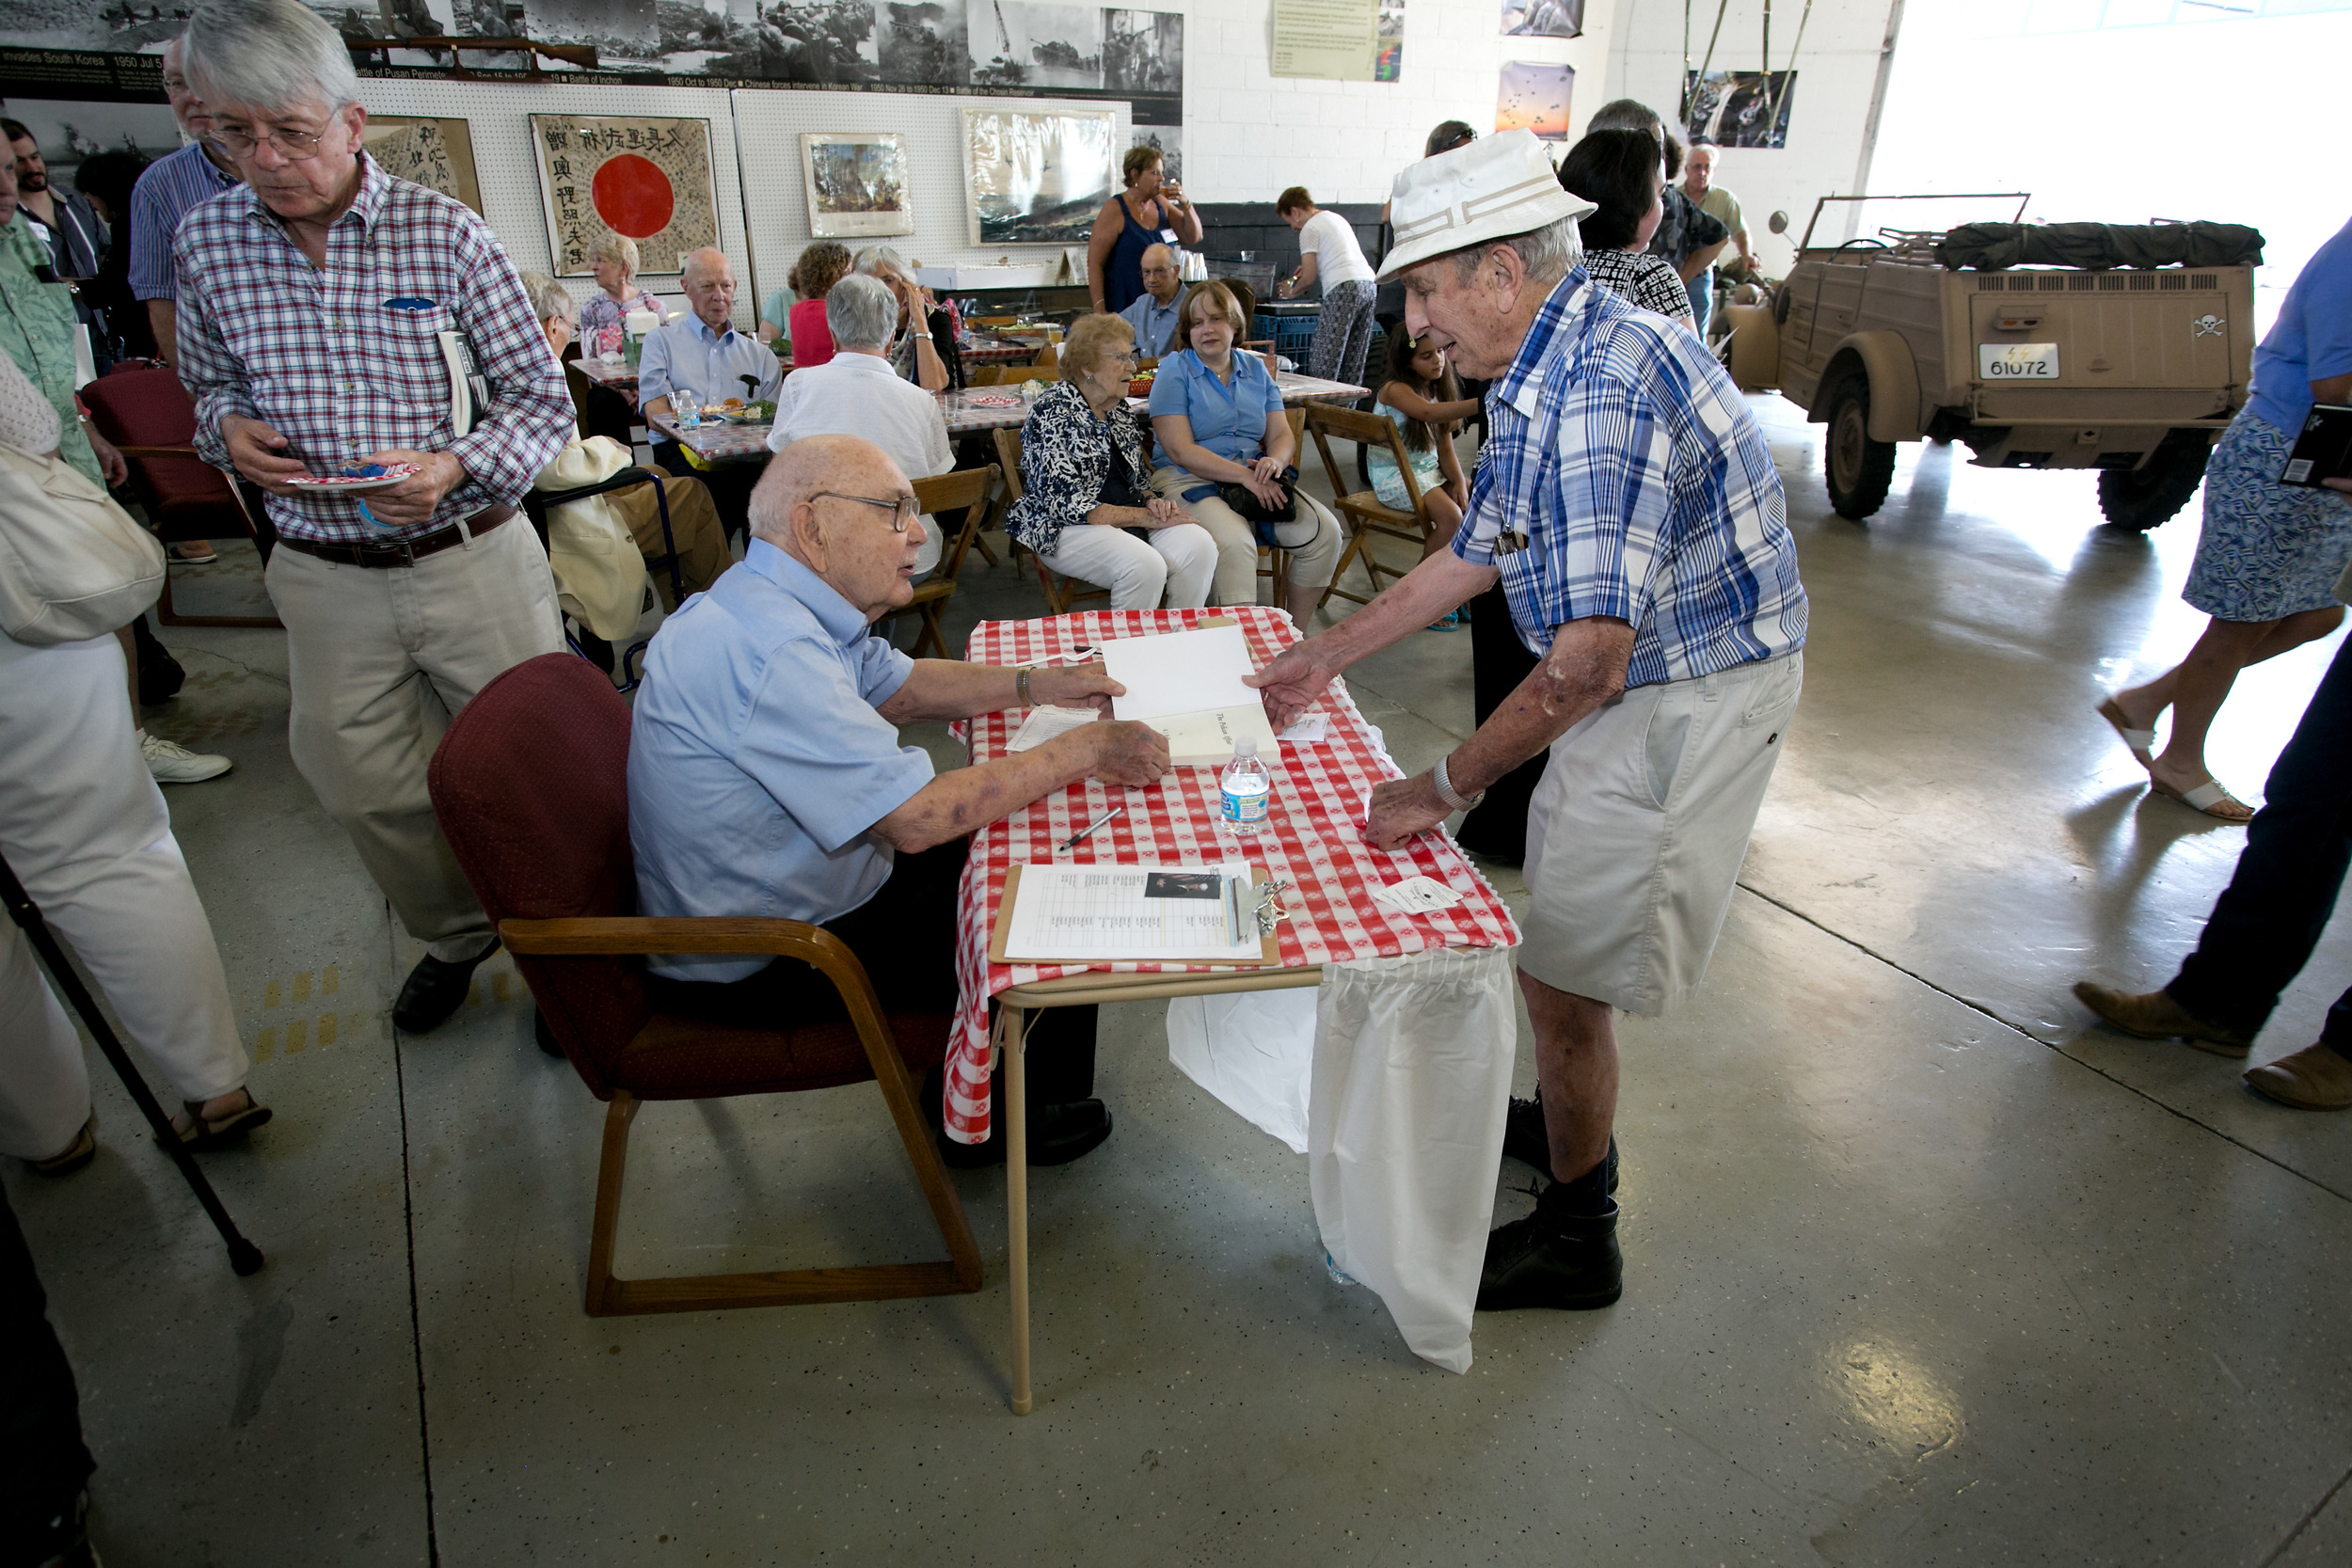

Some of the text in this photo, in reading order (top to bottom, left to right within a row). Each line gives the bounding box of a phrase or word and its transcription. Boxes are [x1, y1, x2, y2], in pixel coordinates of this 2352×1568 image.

[44, 52, 73, 65] South
[75, 54, 105, 67] Korea
[114, 55, 137, 68] 1950
[140, 57, 154, 69] Jul
[356, 67, 373, 77] attle
[375, 68, 384, 78] of
[385, 68, 411, 79] Pusan
[569, 75, 623, 86] Battle of Inchon
[667, 77, 737, 88] 1950 Oct to 1950 Dec
[745, 80, 771, 89] Chinese
[771, 81, 791, 90] forces
[792, 81, 820, 90] intervene
[828, 82, 850, 91] Korean
[850, 83, 863, 91] War
[870, 84, 884, 92] 1950
[885, 84, 898, 93] Nov
[906, 85, 913, 93] to
[914, 85, 928, 93] 1950
[929, 86, 941, 94] Dec
[942, 86, 949, 94] 13
[956, 87, 971, 95] Battle
[973, 87, 979, 95] of
[979, 87, 988, 95] the
[989, 87, 1009, 96] Chosin
[1009, 87, 1034, 97] Reservoir
[1991, 360, 2047, 375] 61072
